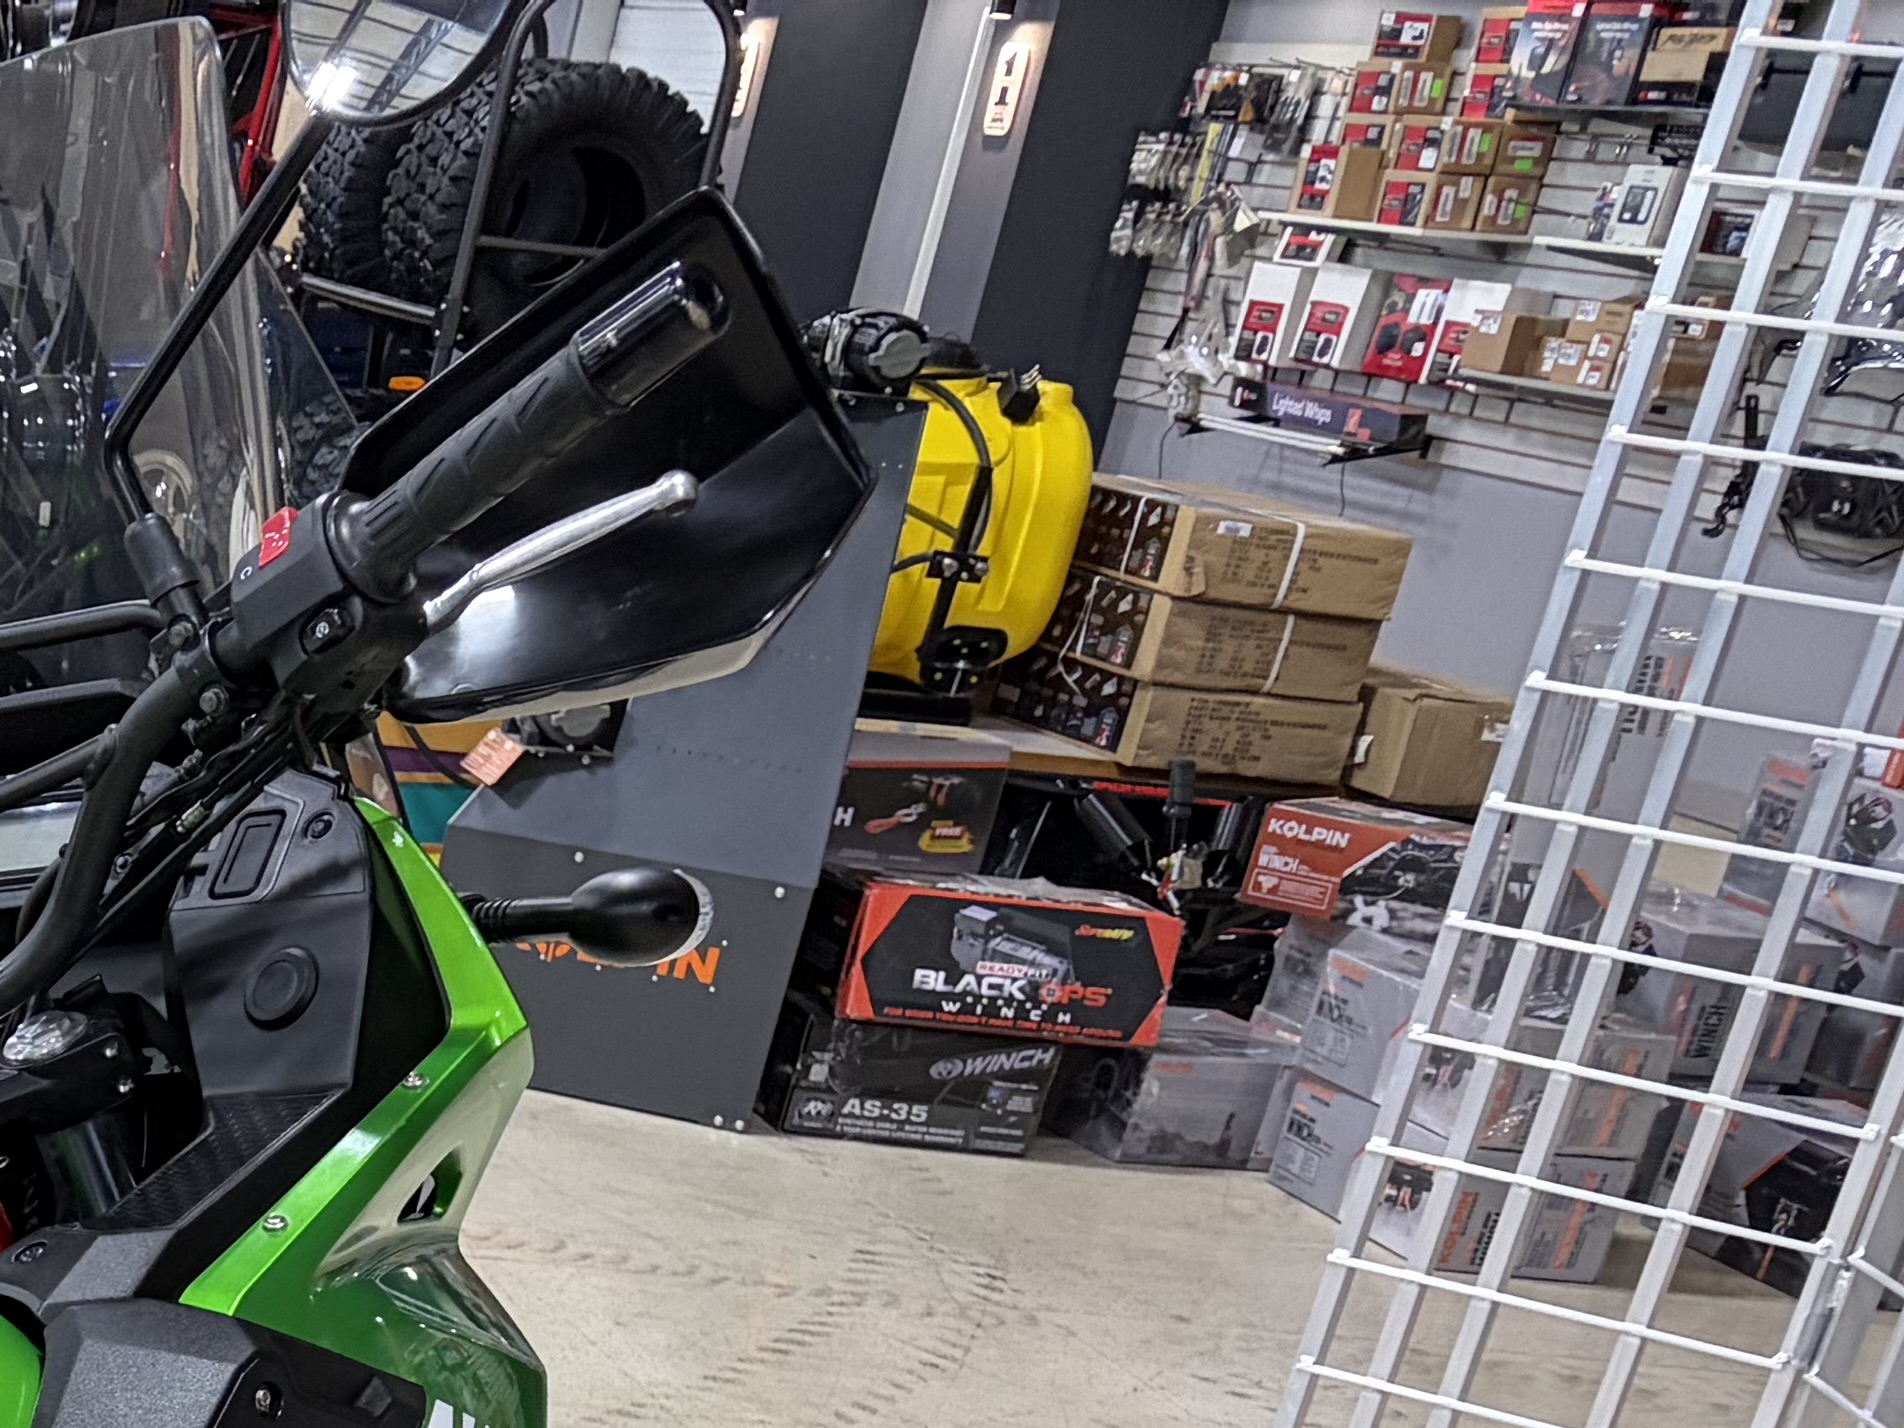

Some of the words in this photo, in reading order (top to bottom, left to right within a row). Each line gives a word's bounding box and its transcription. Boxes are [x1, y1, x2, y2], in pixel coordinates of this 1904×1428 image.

[1267, 817, 1351, 849] KOLPIN
[913, 968, 1027, 1001] BLACK
[963, 1047, 1055, 1077] WINCH
[841, 1098, 929, 1123] AS-35
